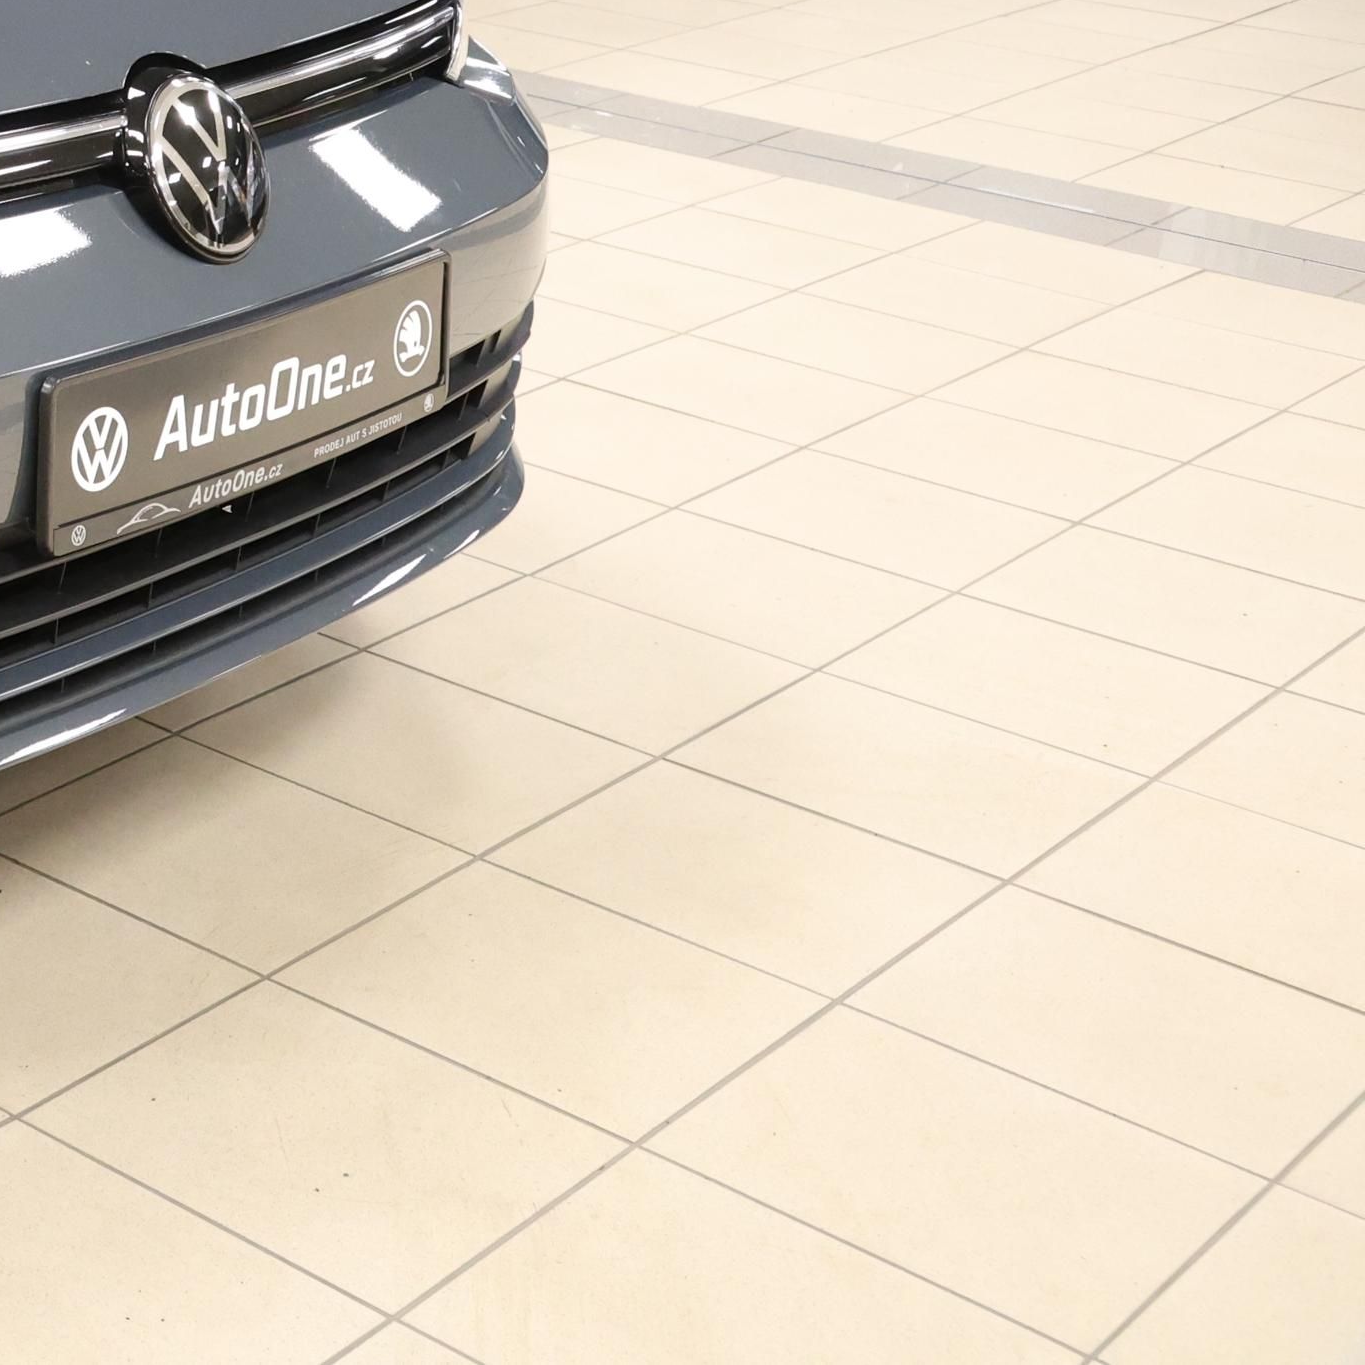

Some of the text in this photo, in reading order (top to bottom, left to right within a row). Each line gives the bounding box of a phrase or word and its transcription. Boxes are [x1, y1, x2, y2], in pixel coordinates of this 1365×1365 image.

[153, 354, 375, 461] AutoOne.cz
[314, 439, 345, 458] PRODEJ
[345, 431, 361, 446] AUT
[368, 412, 403, 435] JISTOTOU
[188, 463, 284, 509] AutoOne.cz
